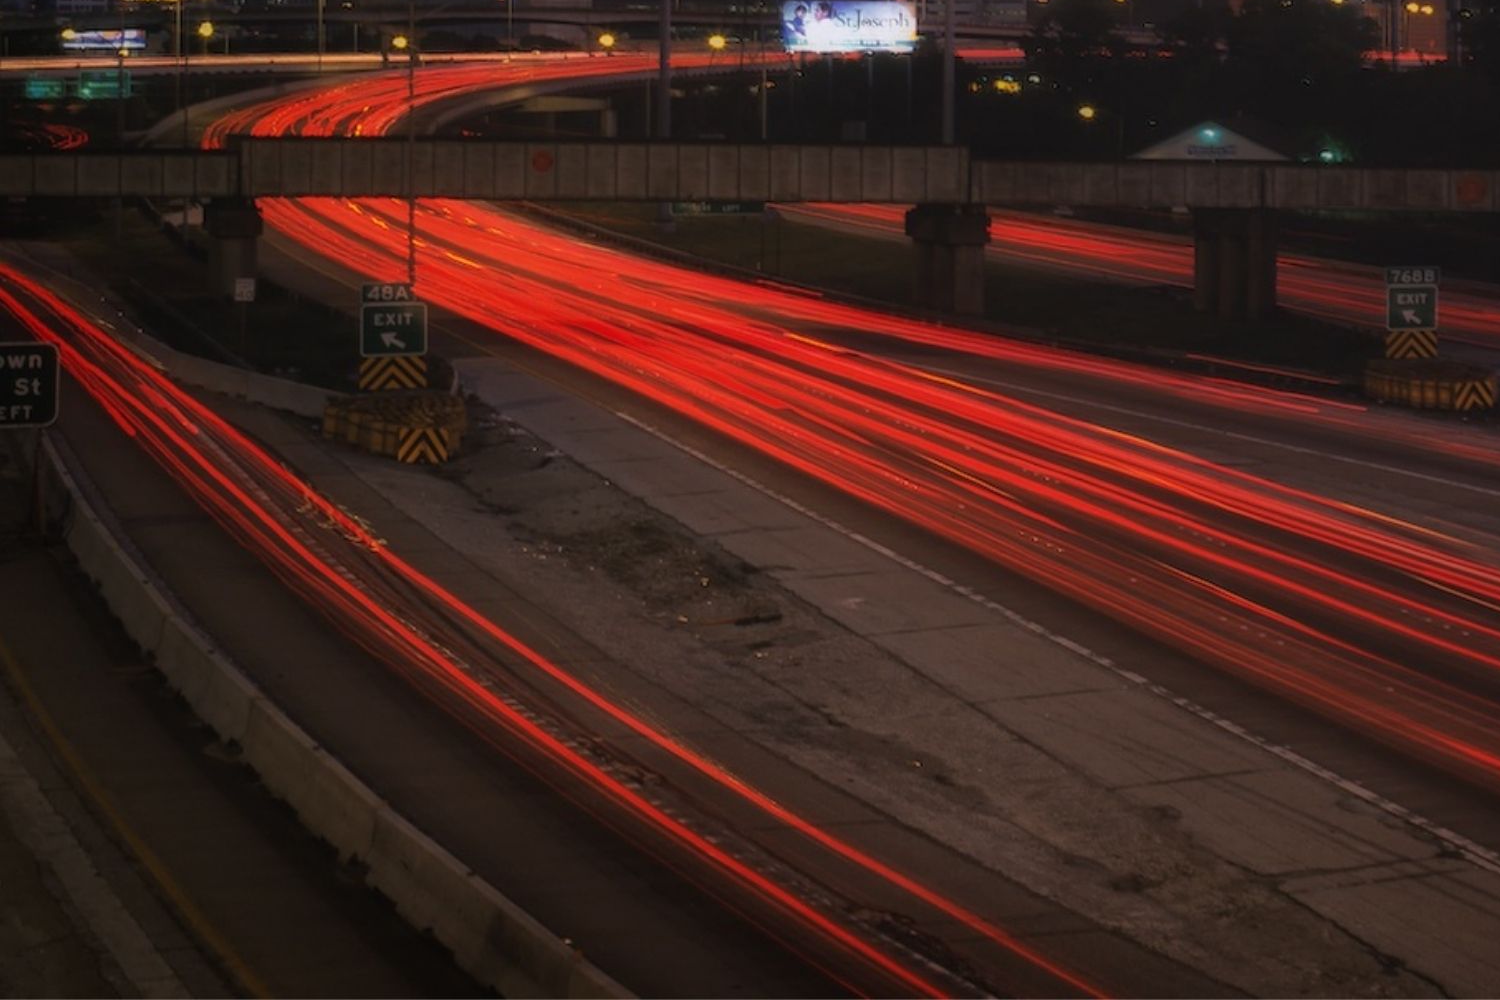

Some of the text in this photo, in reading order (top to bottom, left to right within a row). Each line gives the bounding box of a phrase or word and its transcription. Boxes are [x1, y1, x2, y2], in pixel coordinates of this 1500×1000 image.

[853, 8, 910, 31] Joseph
[1391, 269, 1434, 283] 768B
[367, 286, 408, 300] 48A
[1397, 293, 1427, 305] EXIT
[373, 312, 413, 327] EXIT
[14, 377, 41, 396] St
